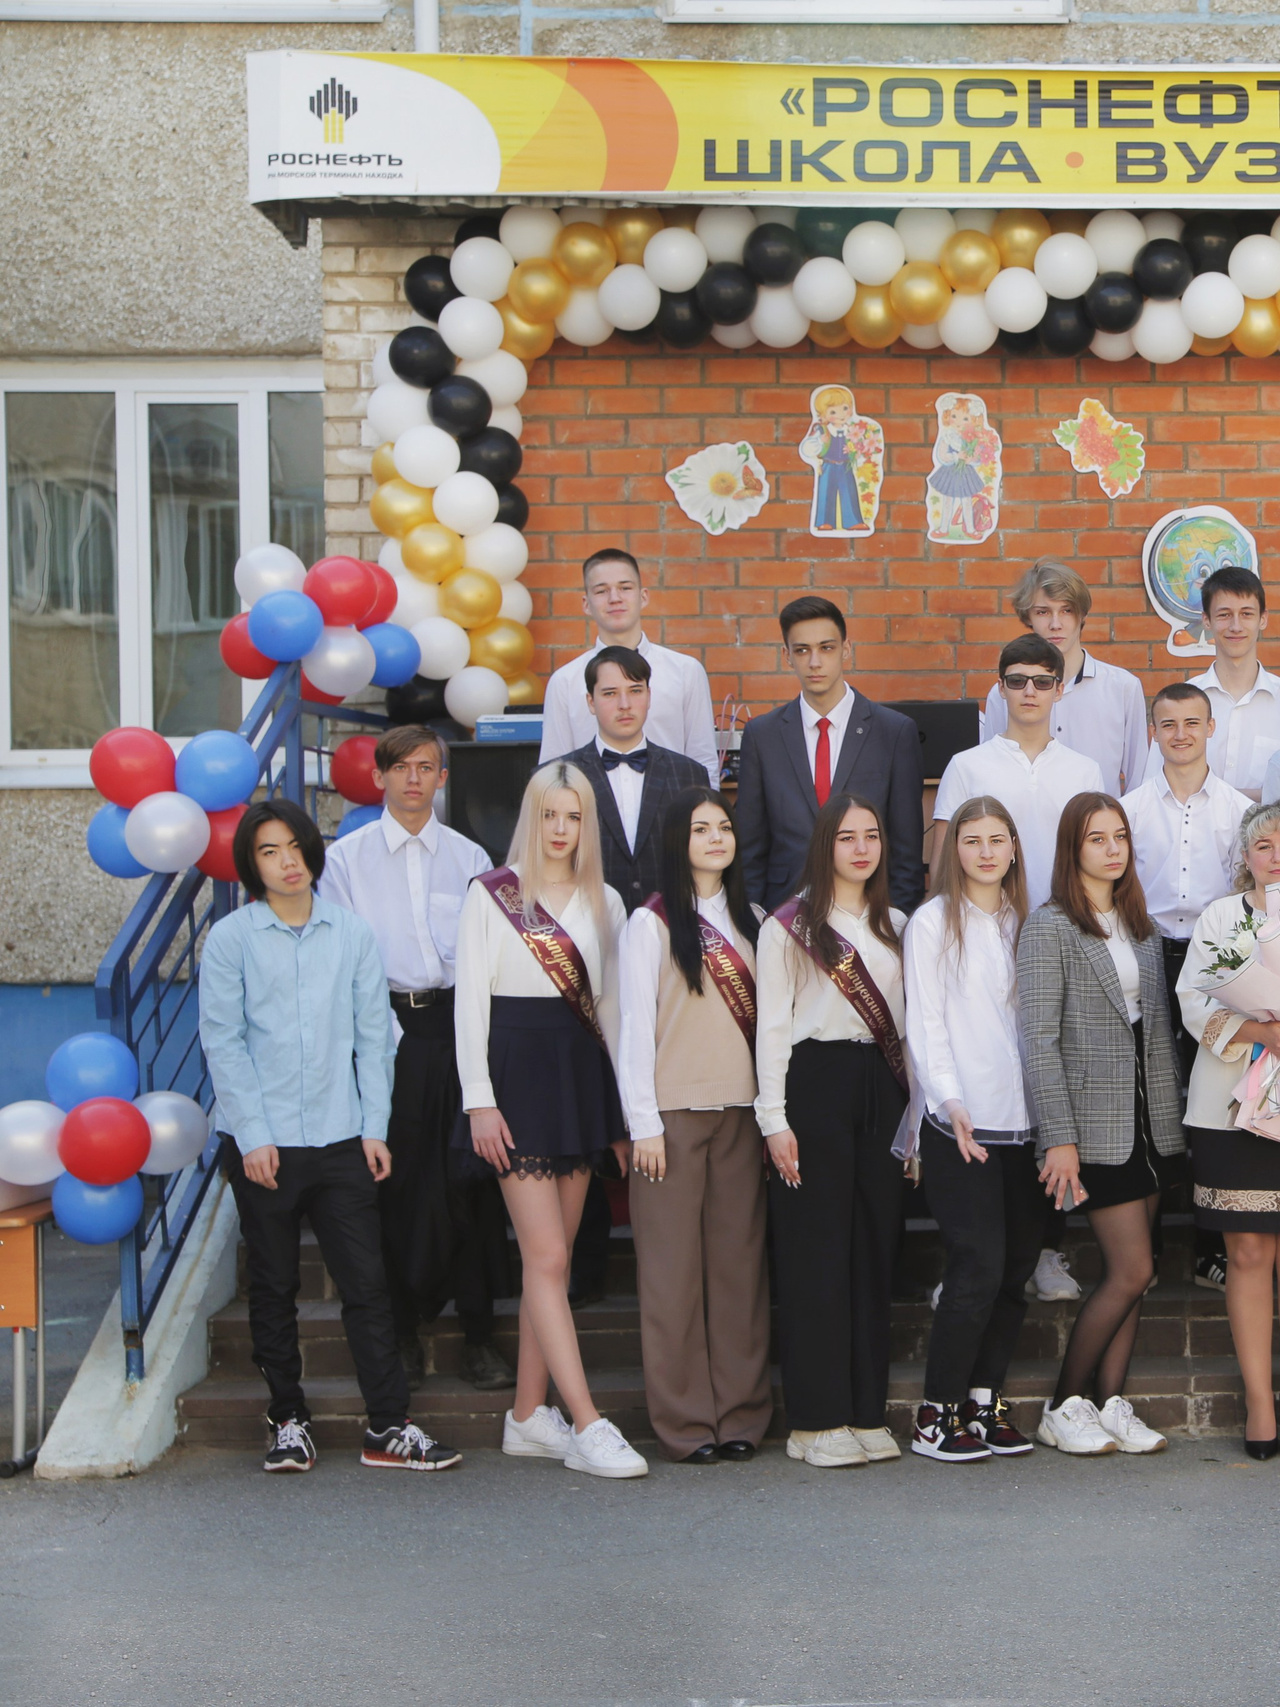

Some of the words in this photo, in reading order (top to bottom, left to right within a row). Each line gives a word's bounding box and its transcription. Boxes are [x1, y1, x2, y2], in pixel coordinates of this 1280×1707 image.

[267, 153, 403, 166] РОСНЕФТЬ
[703, 138, 1042, 184] ШКОЛА
[365, 172, 403, 180] НАХОДКА
